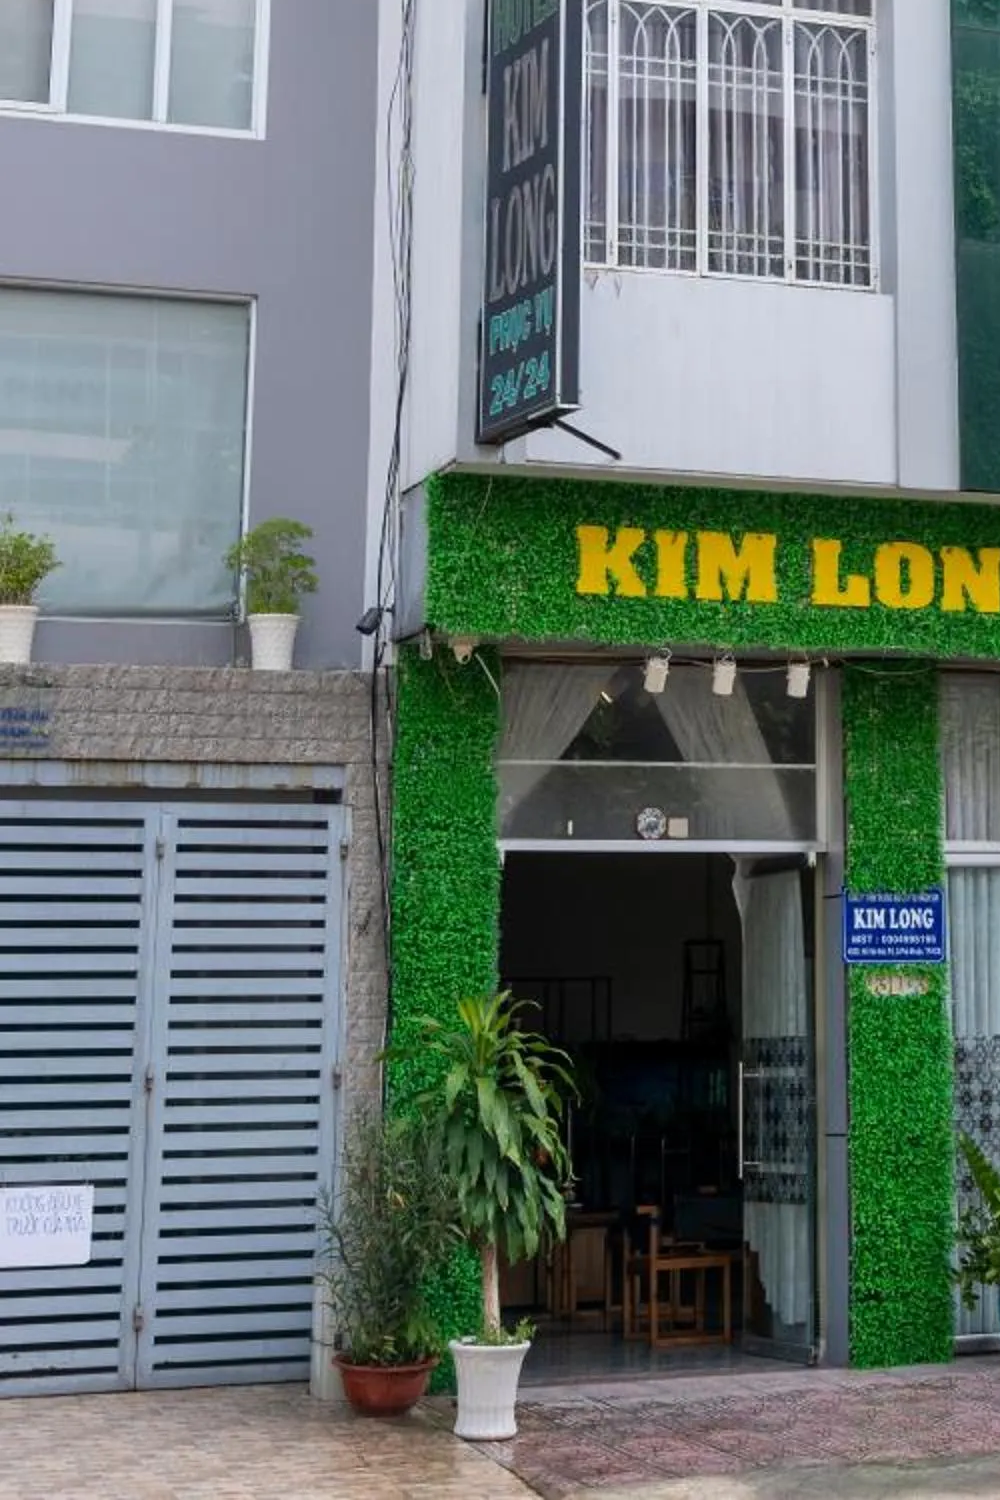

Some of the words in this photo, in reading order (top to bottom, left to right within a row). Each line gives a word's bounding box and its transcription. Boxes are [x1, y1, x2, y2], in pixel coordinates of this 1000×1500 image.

[503, 40, 549, 173] KIM
[488, 164, 555, 303] LONG
[490, 350, 549, 416] 24/24
[576, 524, 777, 603] KIM
[853, 908, 885, 929] KIM
[889, 908, 934, 929] LONG
